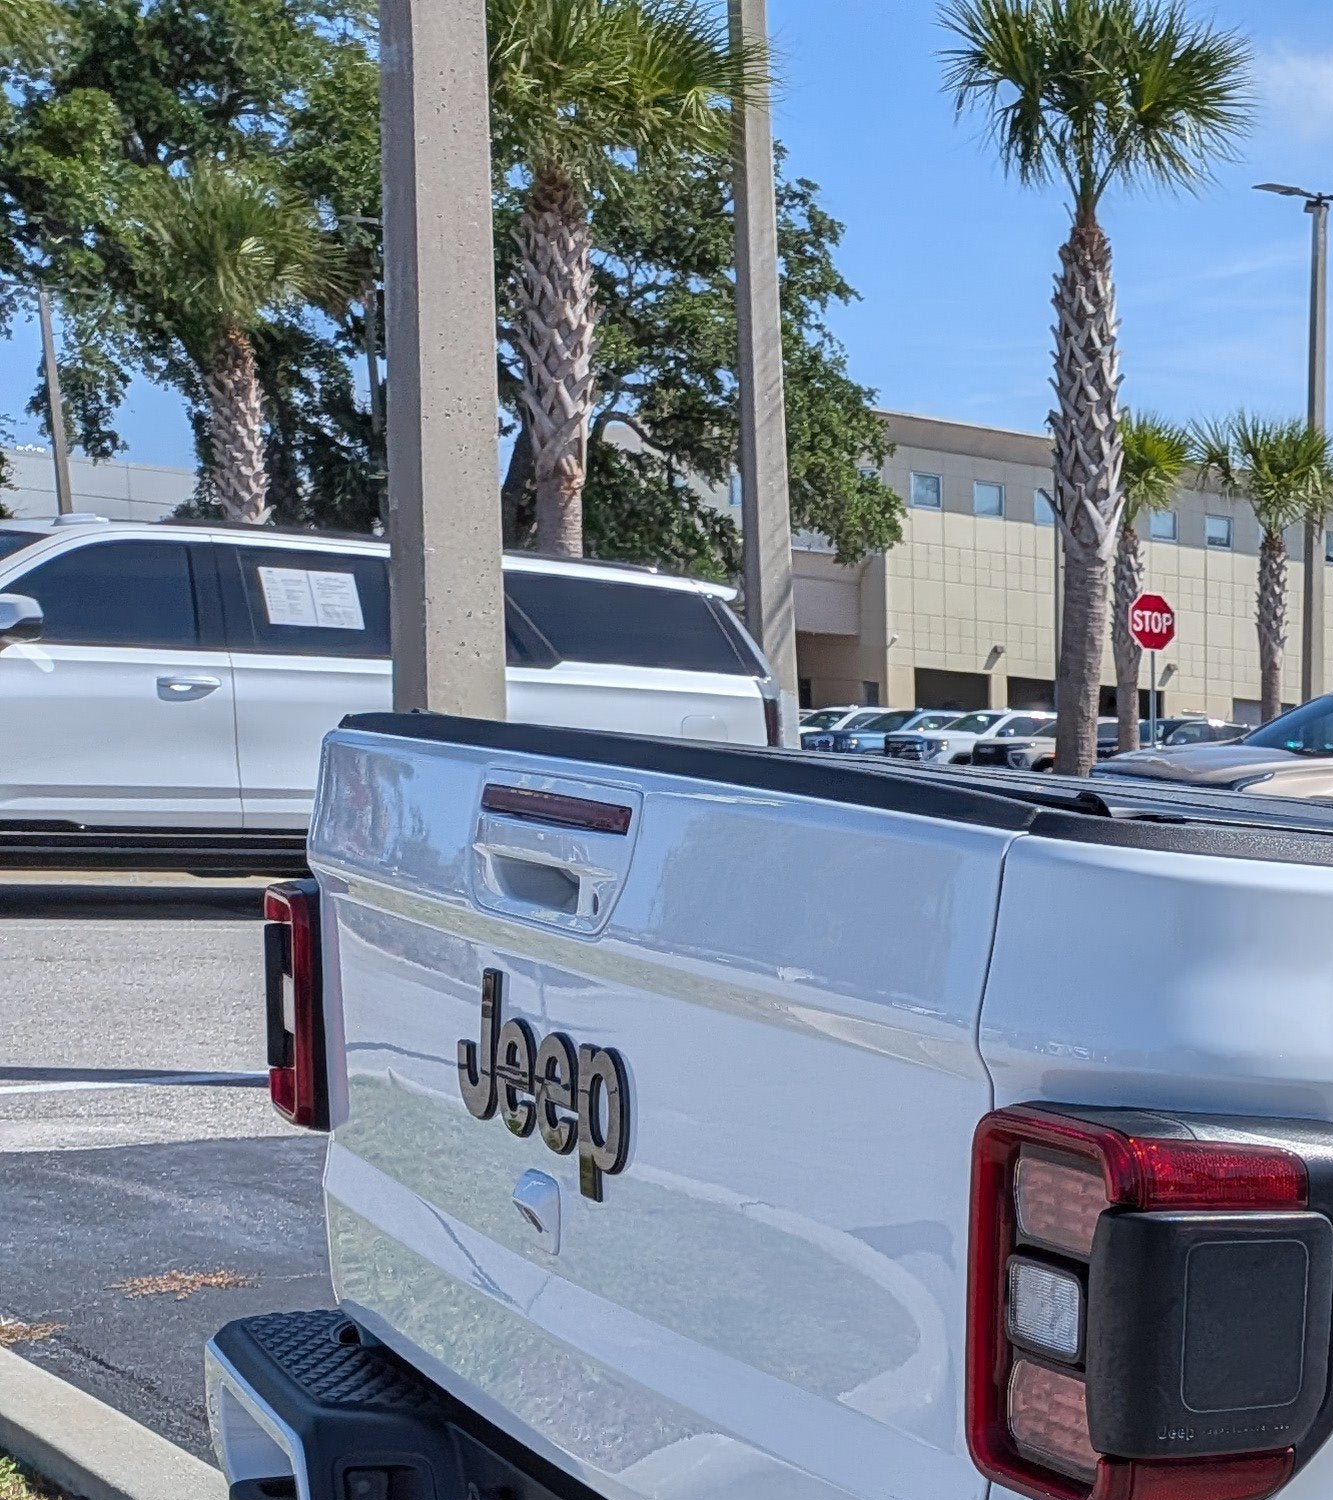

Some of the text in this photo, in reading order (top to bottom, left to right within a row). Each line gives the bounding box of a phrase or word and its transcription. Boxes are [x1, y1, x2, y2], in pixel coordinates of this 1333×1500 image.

[1132, 609, 1173, 634] STOP
[457, 967, 630, 1203] Jeep
[1157, 1425, 1195, 1442] Jeep
